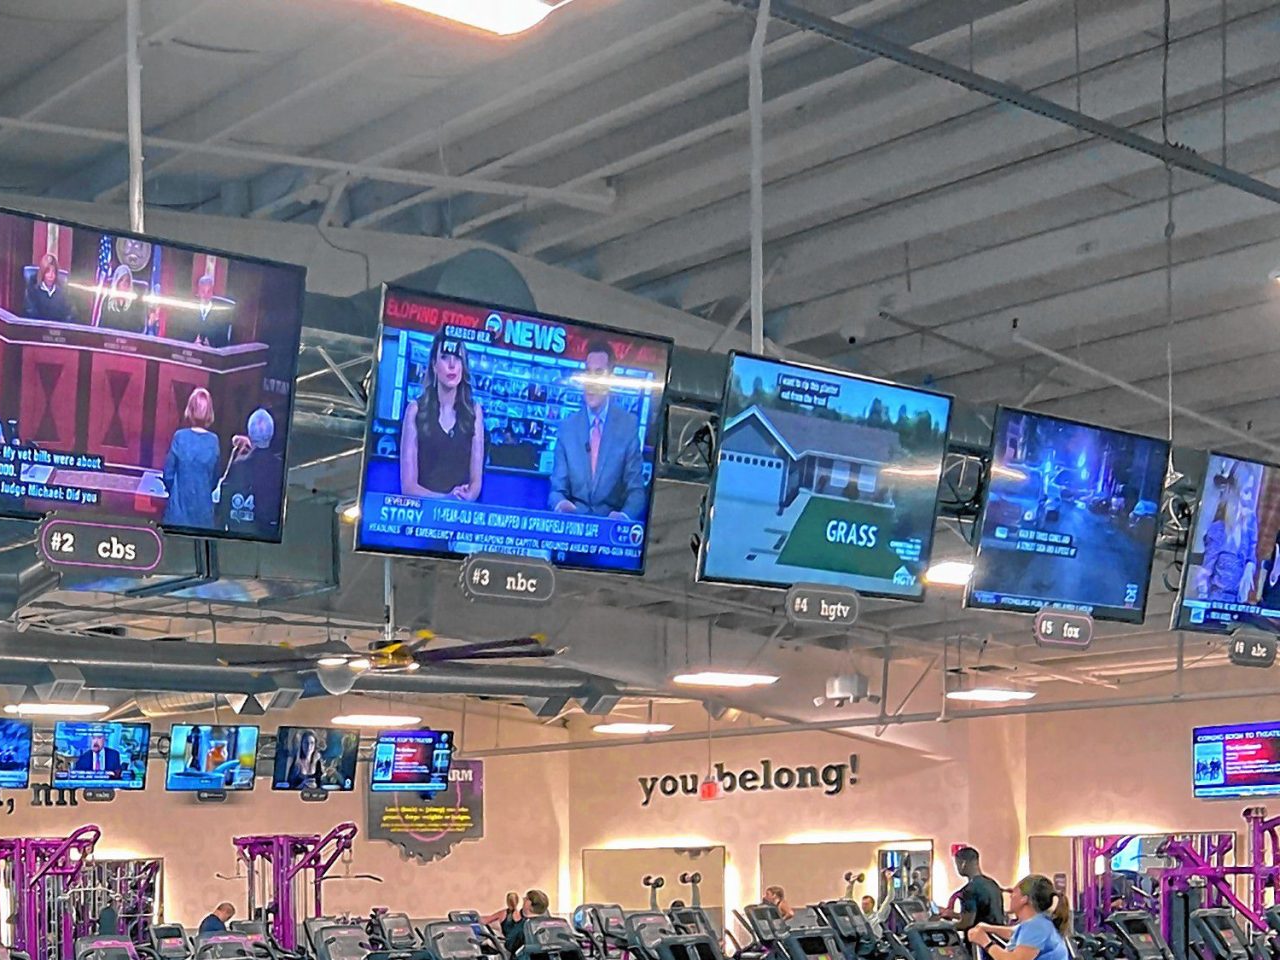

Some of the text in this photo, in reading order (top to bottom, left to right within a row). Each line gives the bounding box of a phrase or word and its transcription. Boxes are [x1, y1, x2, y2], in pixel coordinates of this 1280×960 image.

[504, 319, 566, 353] NEWS
[3, 446, 101, 469] My vet bills were about
[1, 481, 26, 497] Judge
[66, 491, 80, 502] Did
[82, 493, 98, 504] you
[380, 507, 423, 522] STORY
[405, 526, 414, 536] OF
[457, 532, 473, 541] BANS
[474, 533, 504, 544] WEAPONS
[505, 536, 514, 546] ON
[515, 537, 539, 549] CAPITOL
[541, 540, 568, 551] GROUNDS
[570, 544, 588, 554] AHEAD
[590, 545, 598, 554] OF
[624, 548, 642, 558] RALLY
[585, 523, 599, 538] SAFE
[826, 520, 878, 547] GRASS
[51, 532, 136, 560] #2 cbs
[472, 568, 537, 592] #3 nbc
[820, 600, 851, 621] hgtv
[1063, 623, 1080, 638] fox
[638, 754, 860, 806] you belong!
